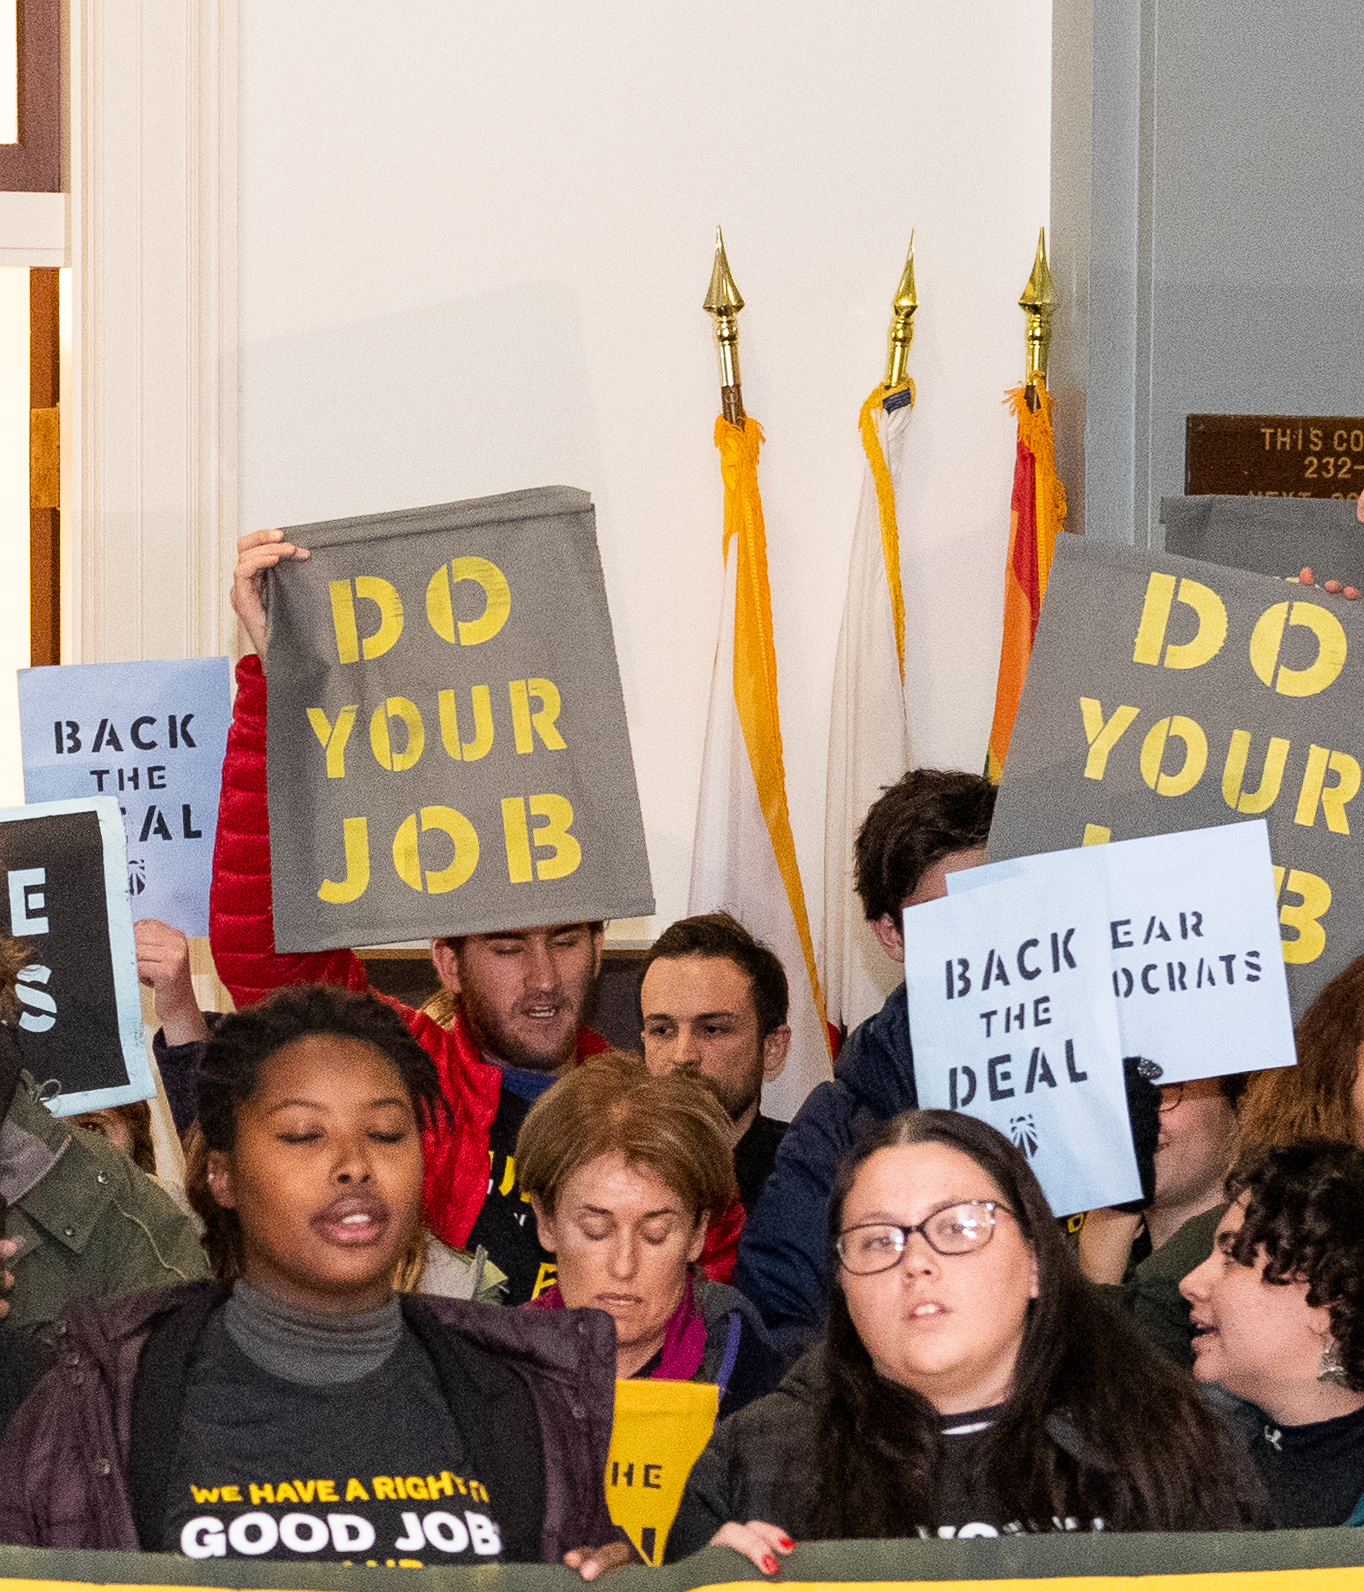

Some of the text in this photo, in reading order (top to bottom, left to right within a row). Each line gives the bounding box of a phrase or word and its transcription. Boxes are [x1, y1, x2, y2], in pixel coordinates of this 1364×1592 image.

[1261, 427, 1323, 451] THIS
[329, 556, 511, 664] DO
[1133, 571, 1348, 697] DO
[54, 713, 197, 754] BACK
[306, 678, 568, 778] YOUR
[90, 765, 167, 792] THE
[1079, 697, 1362, 835] YOUR
[120, 804, 203, 842] AL
[317, 793, 582, 904] JOB
[1110, 911, 1205, 950] EAR
[945, 927, 1077, 1000] BACK
[979, 995, 1052, 1039] THE
[949, 1039, 1088, 1110] DEAL
[190, 1484, 243, 1503] WE
[249, 1480, 339, 1505] HAVE
[345, 1478, 370, 1503] A
[611, 1462, 662, 1489] HE
[180, 1510, 502, 1560] GOOD JOB
